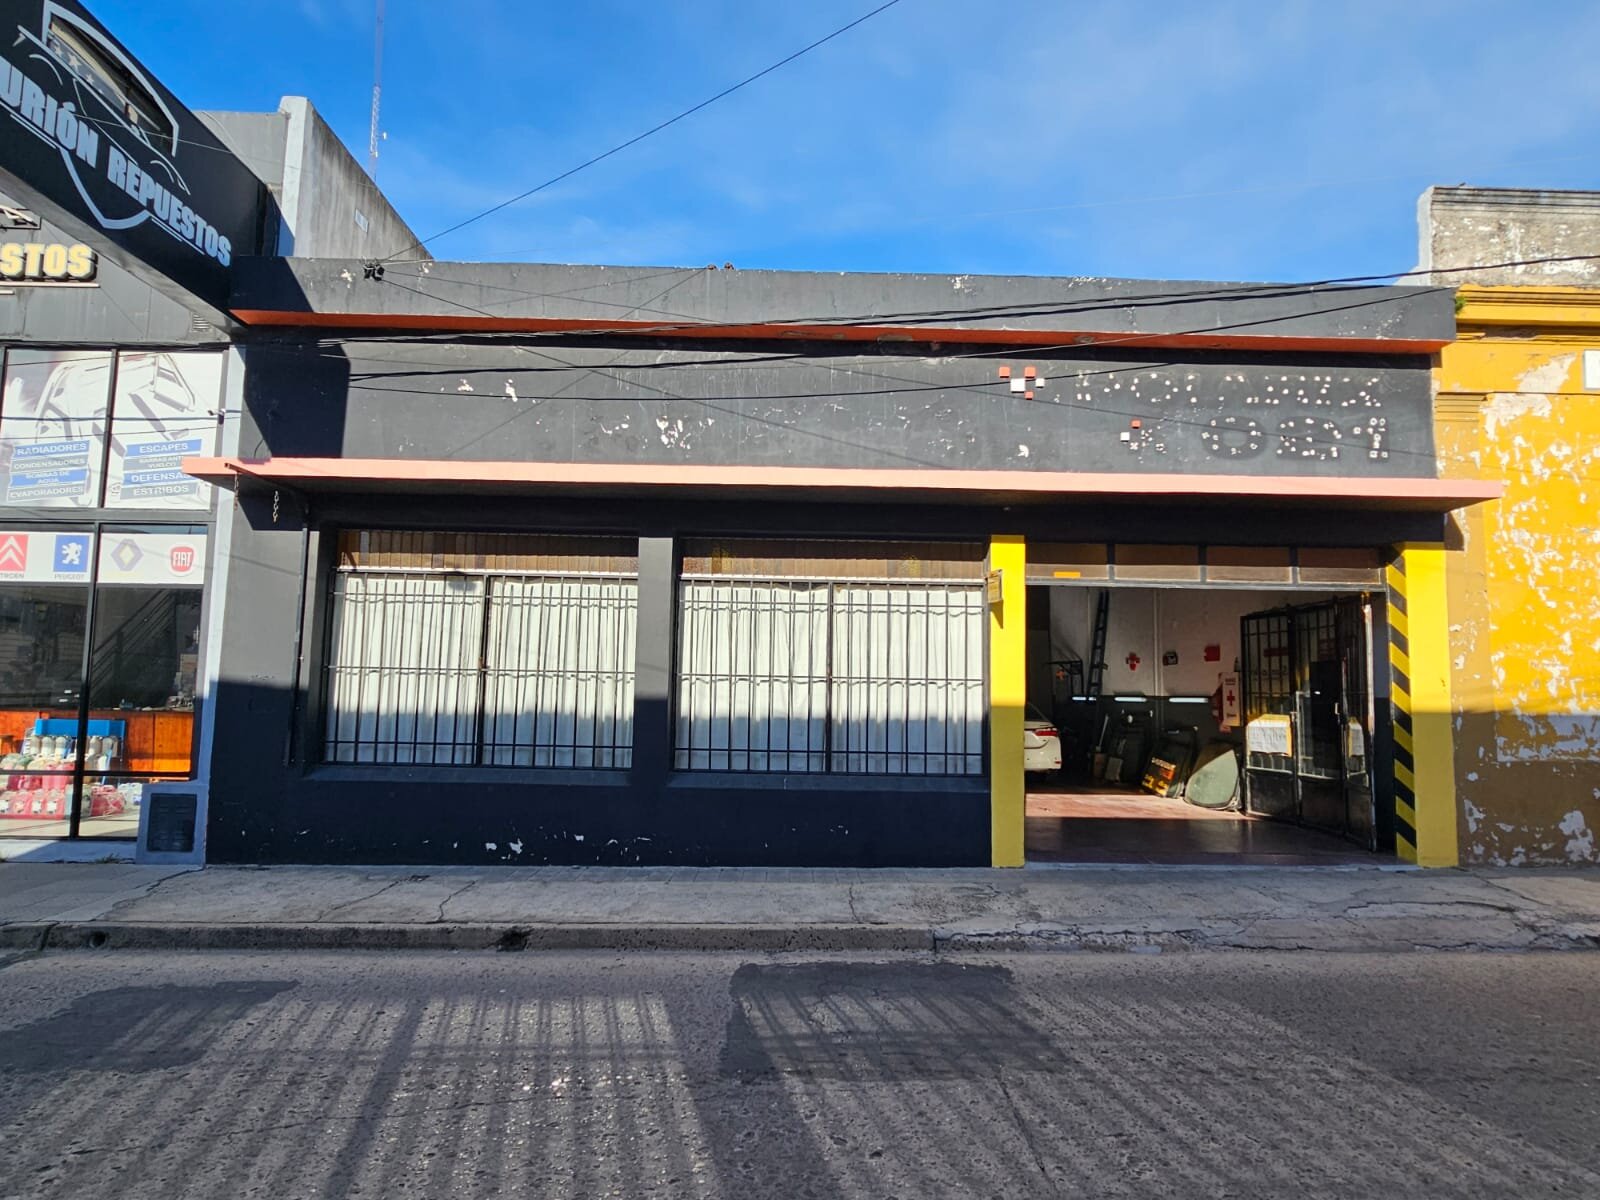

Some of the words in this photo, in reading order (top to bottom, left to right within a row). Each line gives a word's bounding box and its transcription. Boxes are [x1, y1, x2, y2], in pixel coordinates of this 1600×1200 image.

[107, 145, 232, 268] REPUESTOS
[0, 242, 97, 279] STOS
[16, 442, 87, 456] RADIADORES
[139, 442, 189, 454] ESCAPES
[14, 459, 86, 470] CONDENSADORES
[9, 486, 84, 498] EVAPORADORES
[133, 485, 190, 496] ESTRIBOS
[171, 551, 193, 568] FIAT
